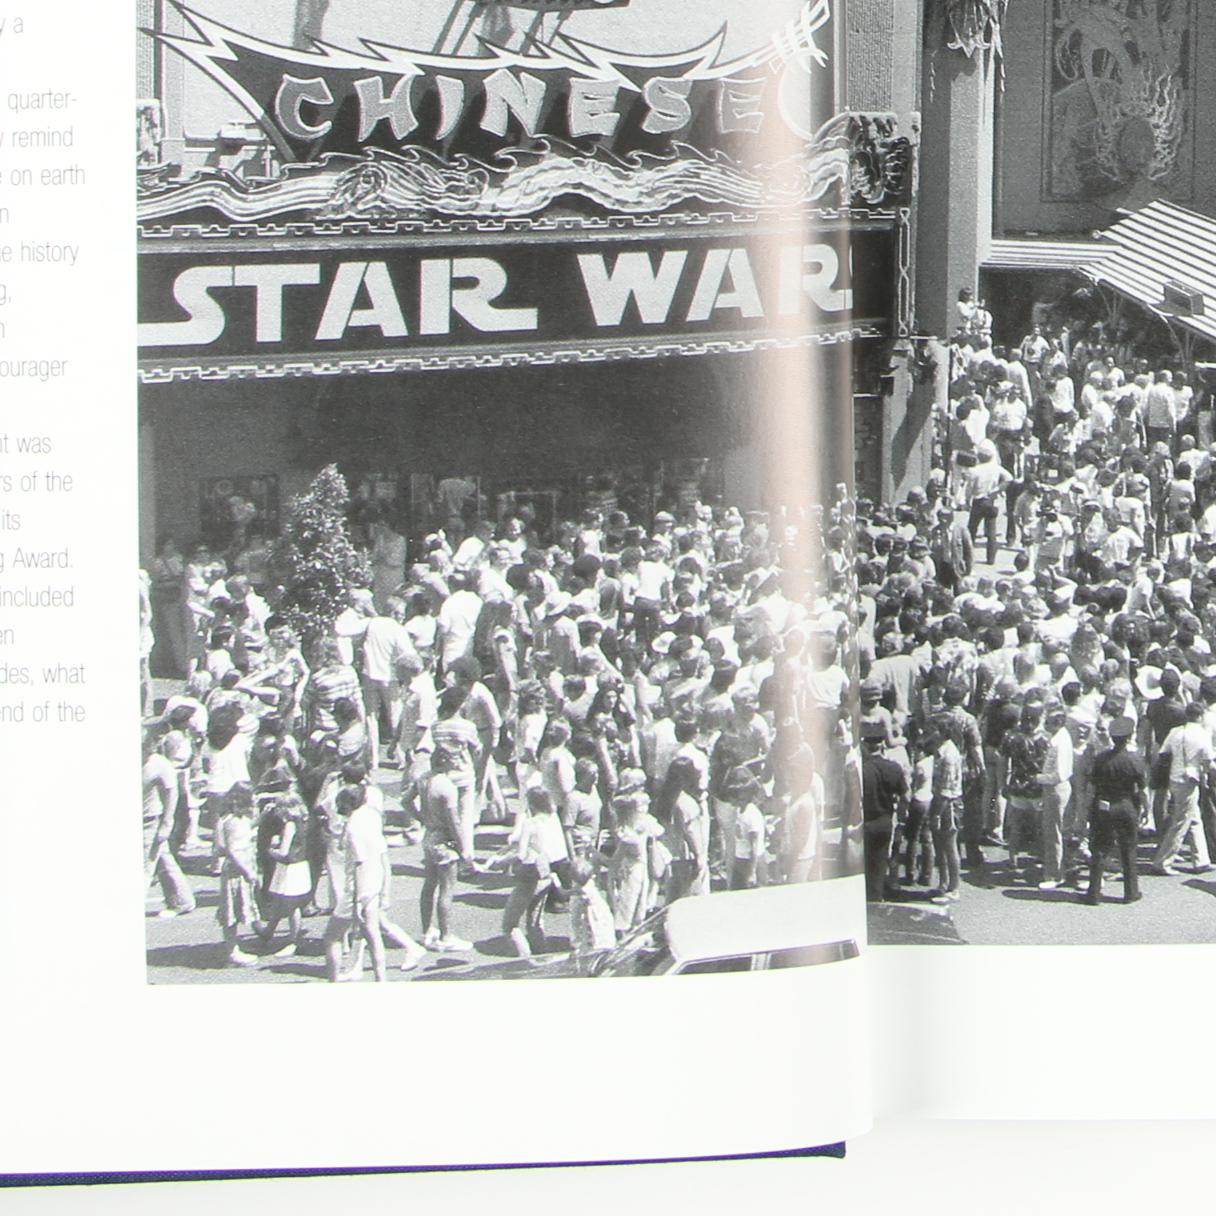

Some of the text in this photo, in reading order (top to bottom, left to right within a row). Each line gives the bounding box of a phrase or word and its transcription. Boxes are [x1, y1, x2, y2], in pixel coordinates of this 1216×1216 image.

[13, 17, 24, 34] a
[8, 88, 77, 114] quarter-
[274, 67, 767, 142] CHINESE
[12, 126, 73, 148] remind
[11, 169, 32, 186] on
[41, 164, 85, 186] earth
[21, 241, 79, 266] history
[136, 243, 854, 347] STAR WAR
[0, 360, 68, 382] ourager
[16, 437, 51, 454] was
[21, 470, 38, 492] of
[44, 471, 73, 492] the
[2, 509, 21, 530] its
[13, 547, 73, 569] Award.
[42, 663, 86, 684] what
[32, 701, 50, 722] of
[57, 701, 85, 722] the
